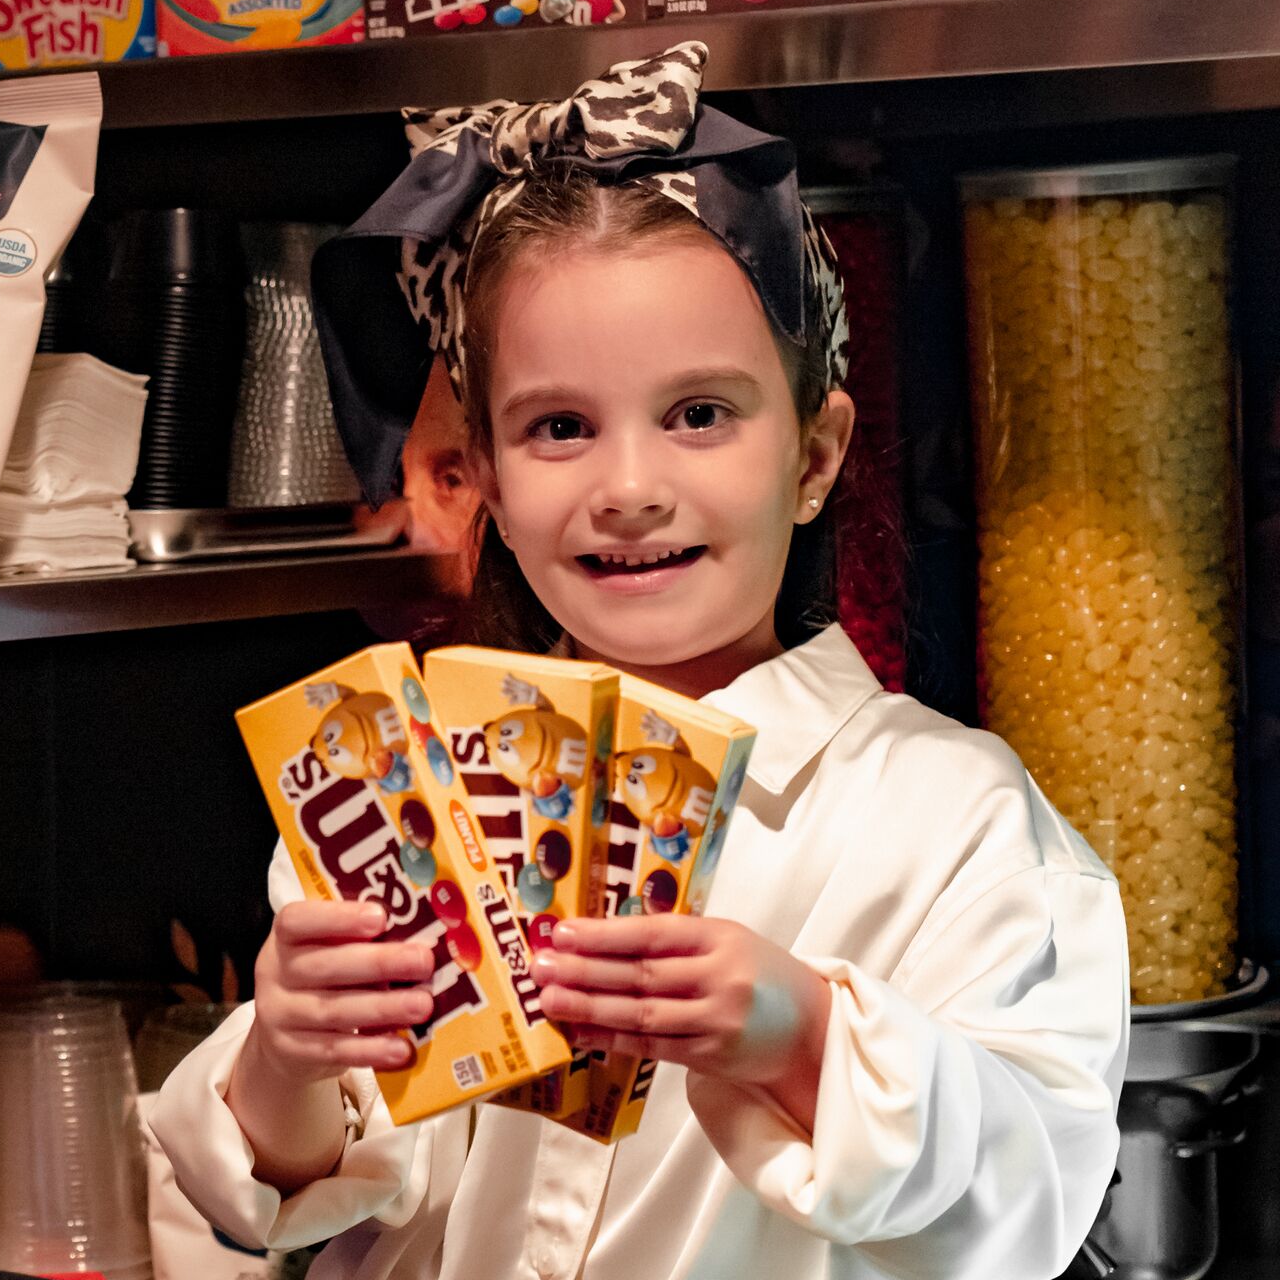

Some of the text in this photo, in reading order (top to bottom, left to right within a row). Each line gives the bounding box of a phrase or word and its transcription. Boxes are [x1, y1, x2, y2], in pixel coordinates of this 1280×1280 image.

[21, 11, 100, 60] Fish
[453, 809, 483, 864] PEANUT
[453, 1060, 472, 1086] 150
